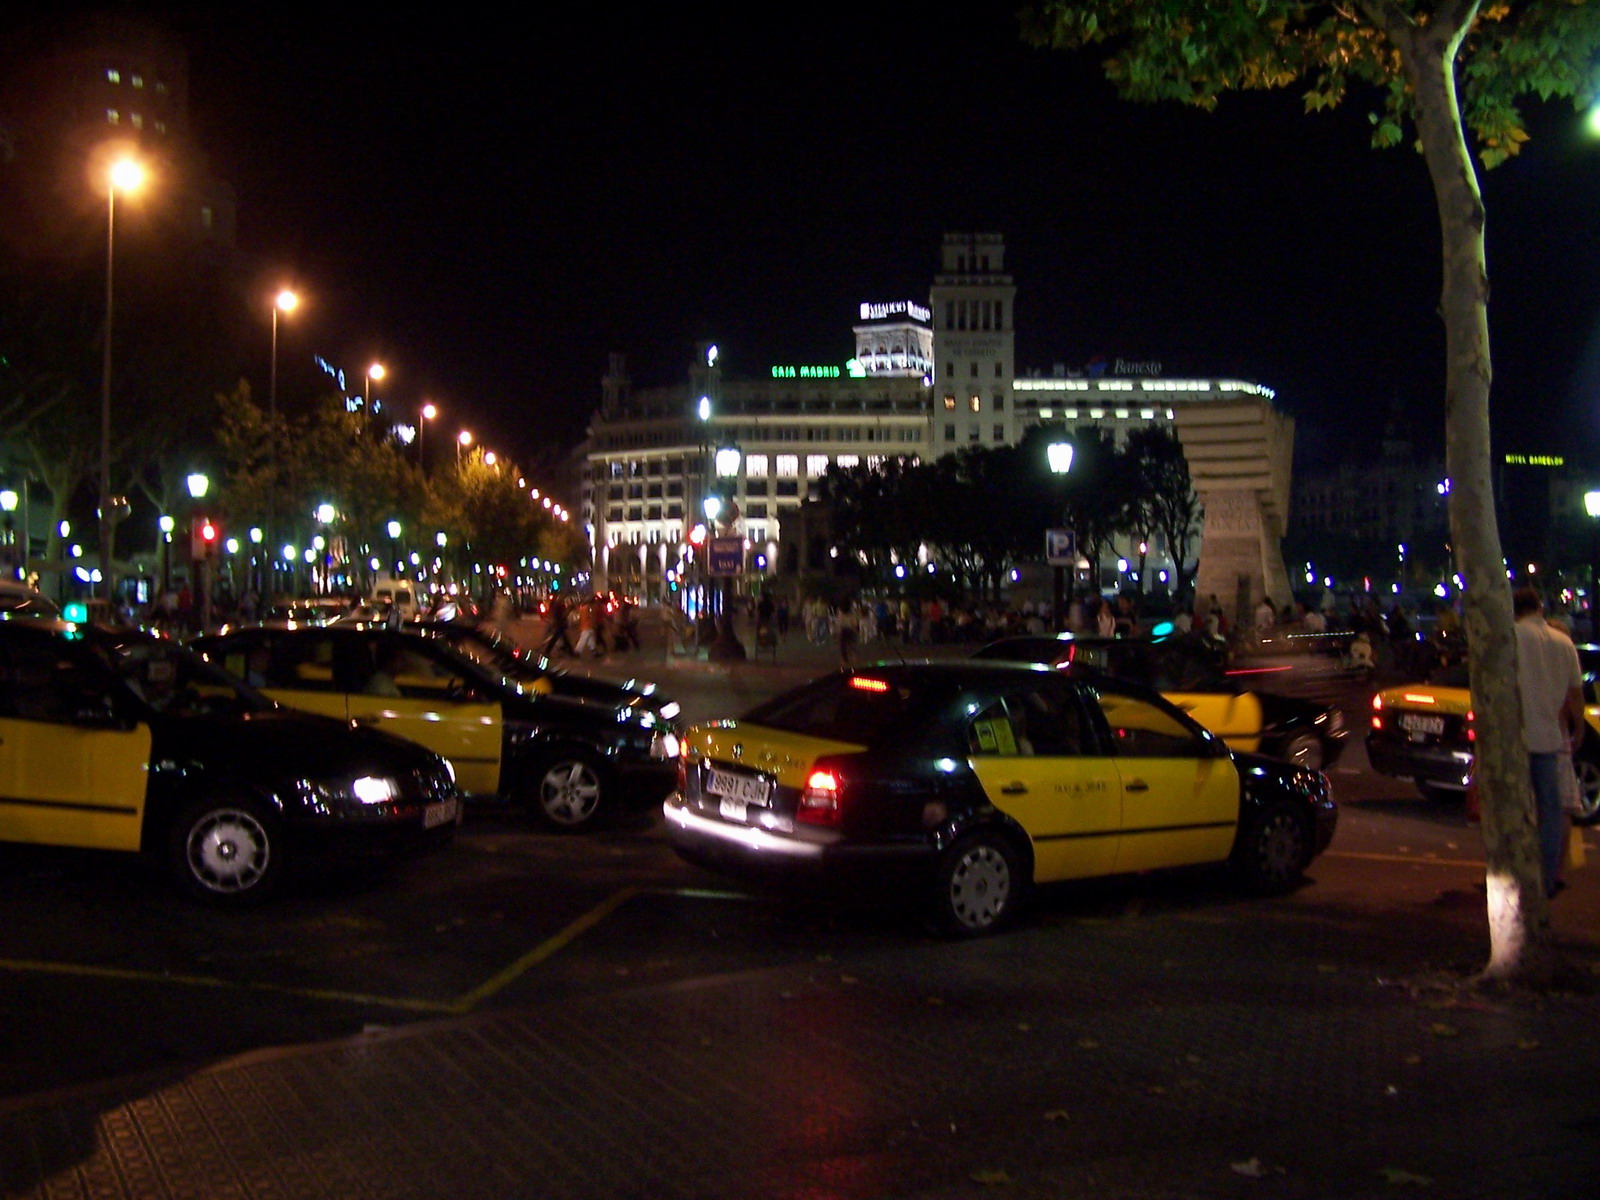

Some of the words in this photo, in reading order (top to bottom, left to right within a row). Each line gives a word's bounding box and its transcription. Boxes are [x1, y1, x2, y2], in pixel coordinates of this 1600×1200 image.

[771, 365, 796, 378] CAJA
[800, 365, 840, 378] MADRID
[1052, 533, 1069, 555] P
